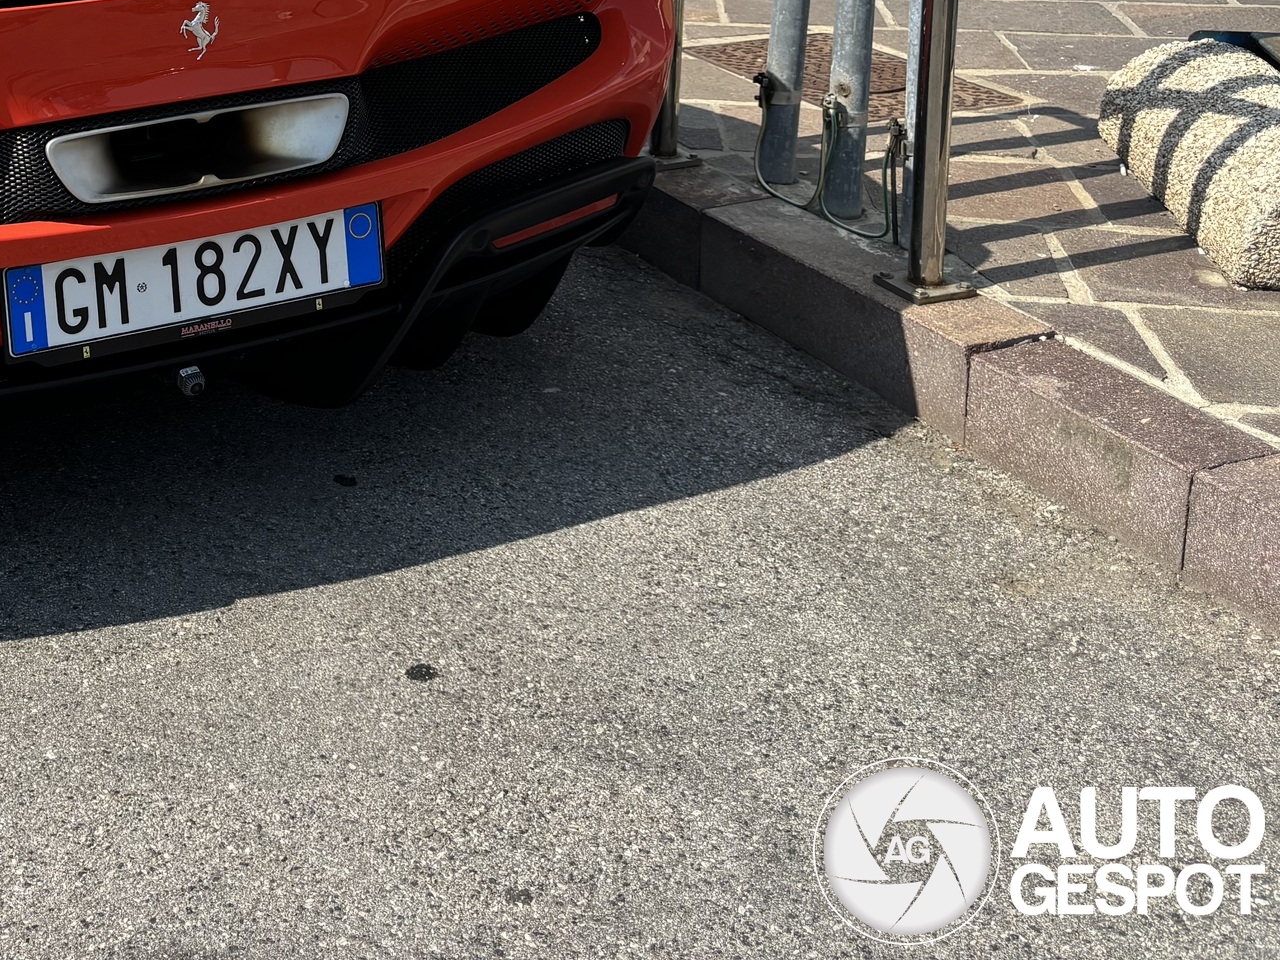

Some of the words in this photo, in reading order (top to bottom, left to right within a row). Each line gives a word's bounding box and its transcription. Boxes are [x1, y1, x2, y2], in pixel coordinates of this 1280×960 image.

[54, 257, 131, 335] GM
[161, 217, 335, 314] 182XY
[181, 318, 232, 335] MARANELLO
